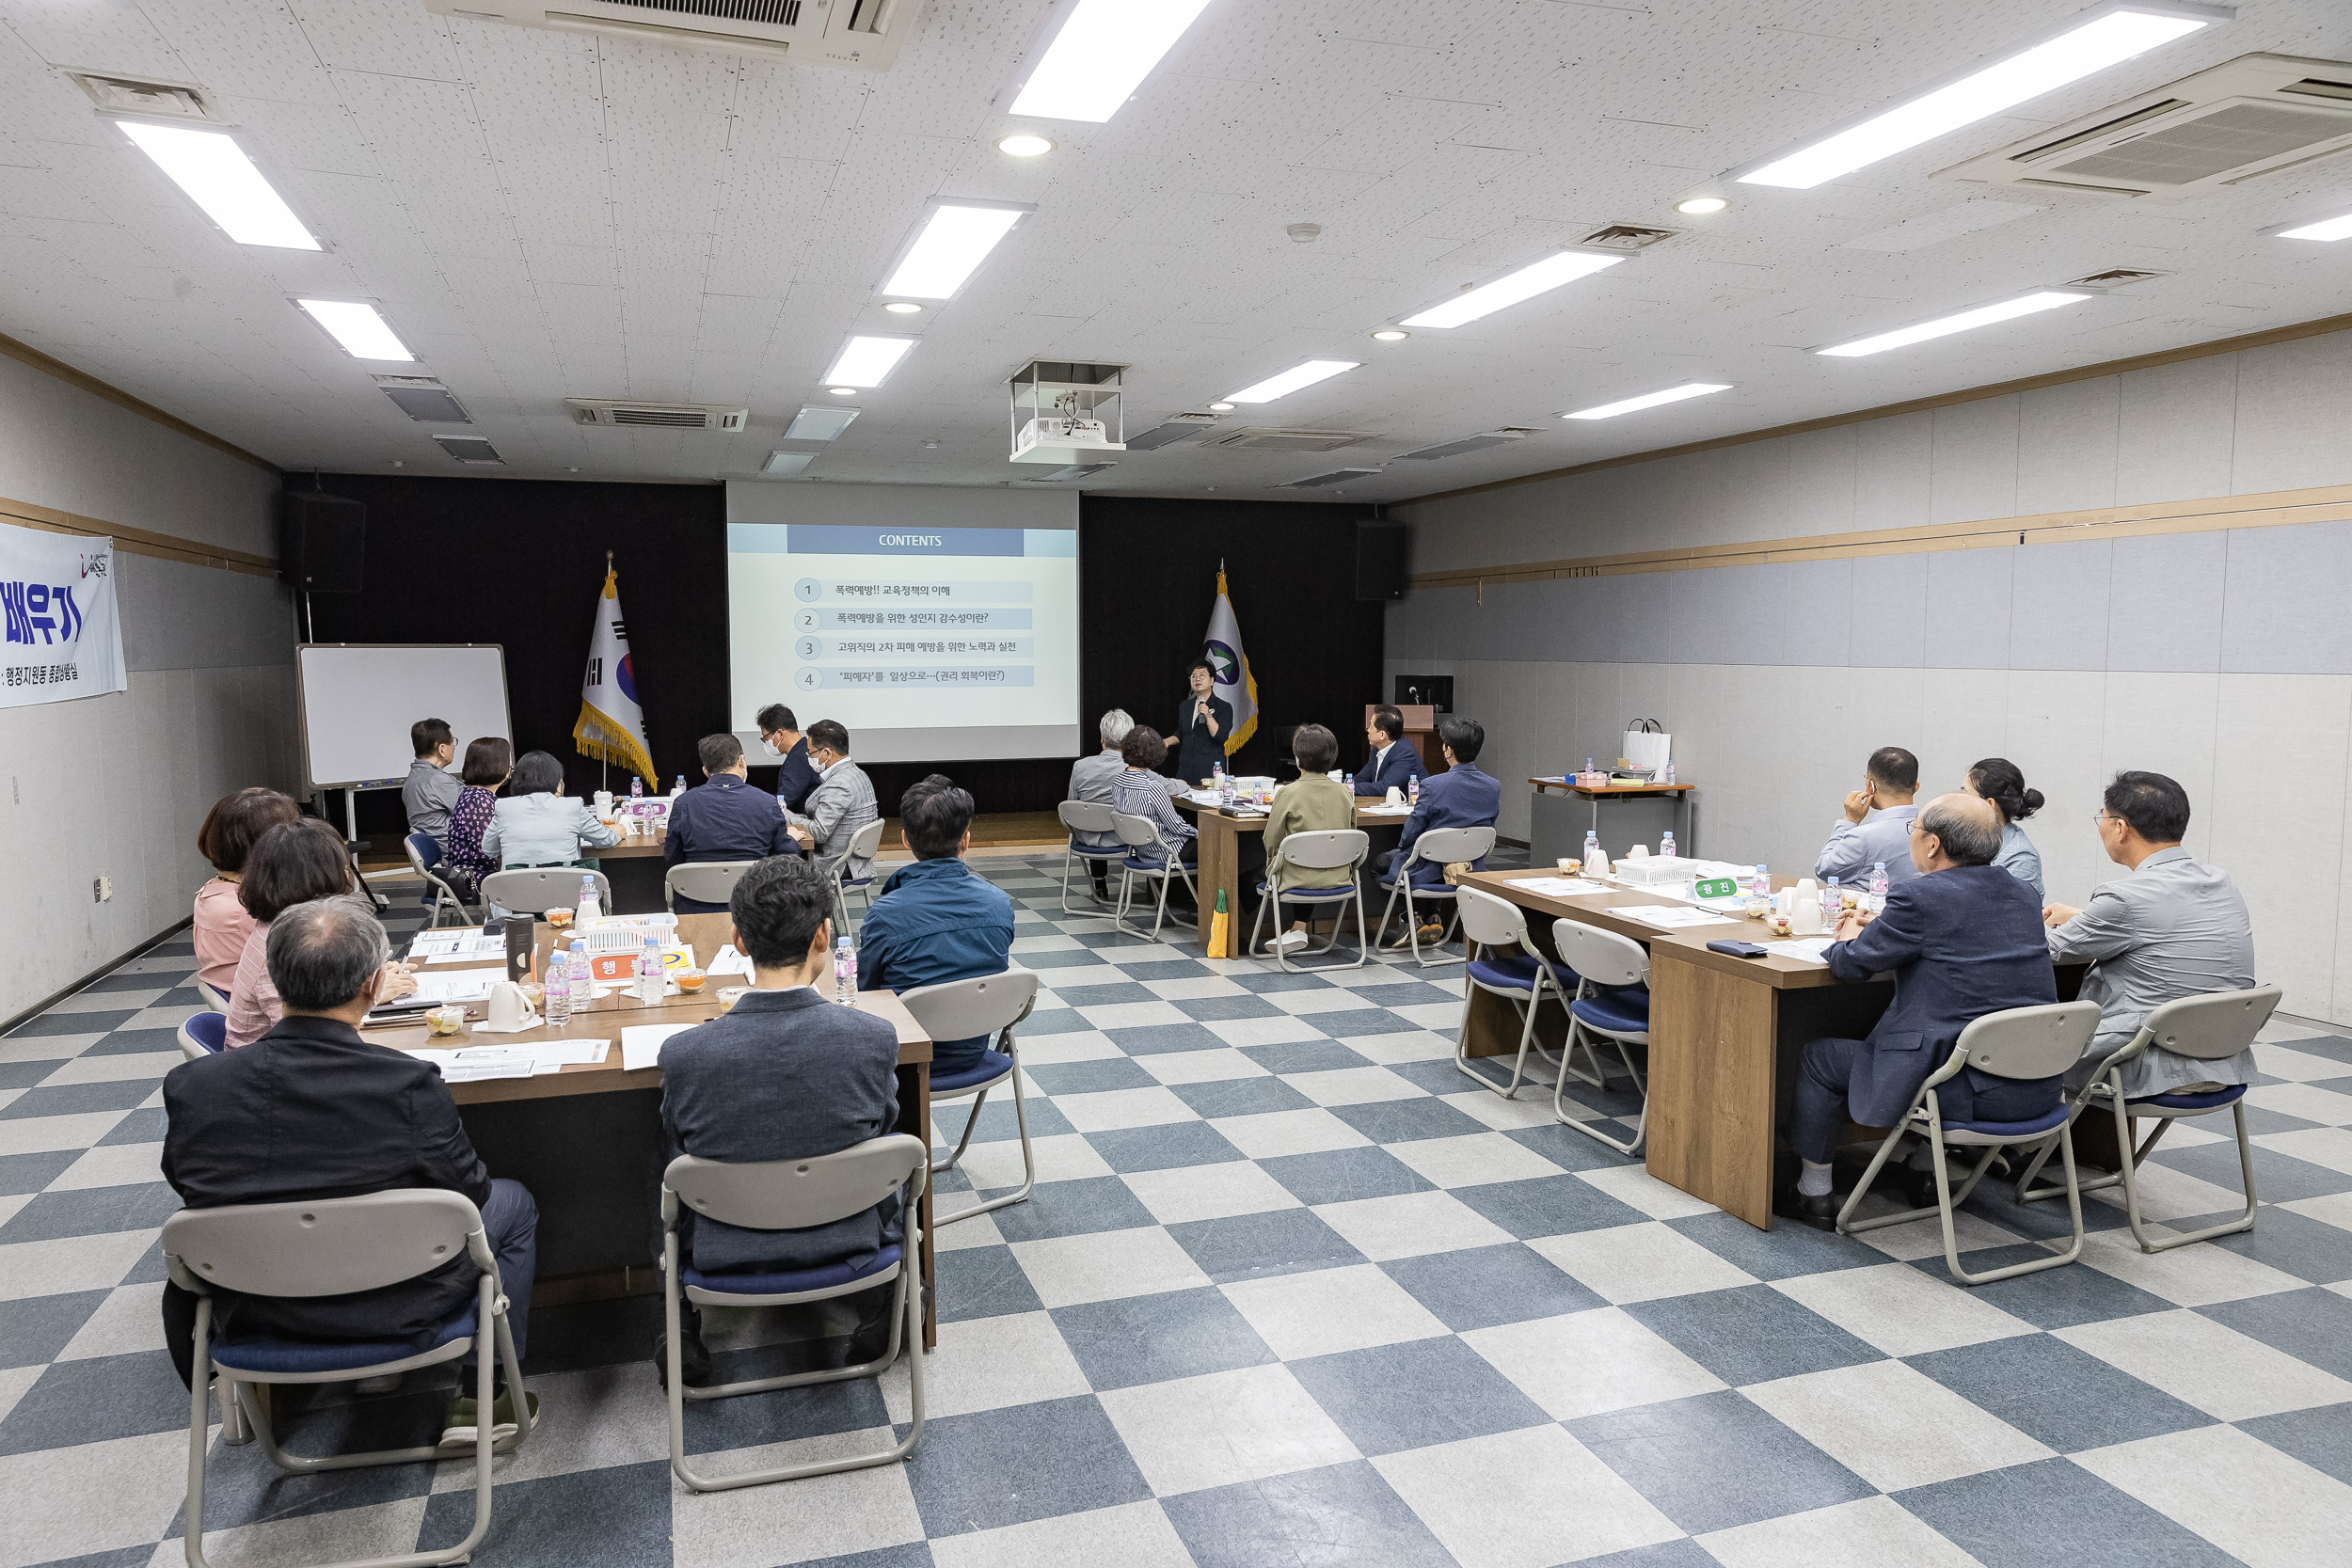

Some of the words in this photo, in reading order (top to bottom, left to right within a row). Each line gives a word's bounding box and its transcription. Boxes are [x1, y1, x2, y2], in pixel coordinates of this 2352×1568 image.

[878, 533, 943, 547] CONTENTS
[804, 585, 811, 594] 1
[835, 585, 880, 596] 폭력예방!!
[882, 585, 929, 596] 교육정책의
[931, 585, 950, 596] 이해
[0, 581, 82, 644] 배우기
[804, 615, 812, 625] 2
[836, 612, 884, 624] 폭력예방을
[887, 612, 906, 624] 위한
[909, 613, 936, 624] 성인지
[939, 612, 989, 624] 감수성이란?
[805, 642, 813, 655] 3
[837, 642, 876, 653] 고위직의
[879, 642, 894, 653] 2차
[897, 641, 915, 653] 피해
[917, 641, 946, 653] 예방을
[947, 641, 966, 652] 위한
[969, 641, 996, 652] 노력과
[998, 641, 1016, 652] 실천
[6, 666, 47, 687] 행정지원동
[49, 662, 78, 683] 종합상황실
[804, 673, 814, 685] 4
[961, 670, 1005, 681] 회복이란?)
